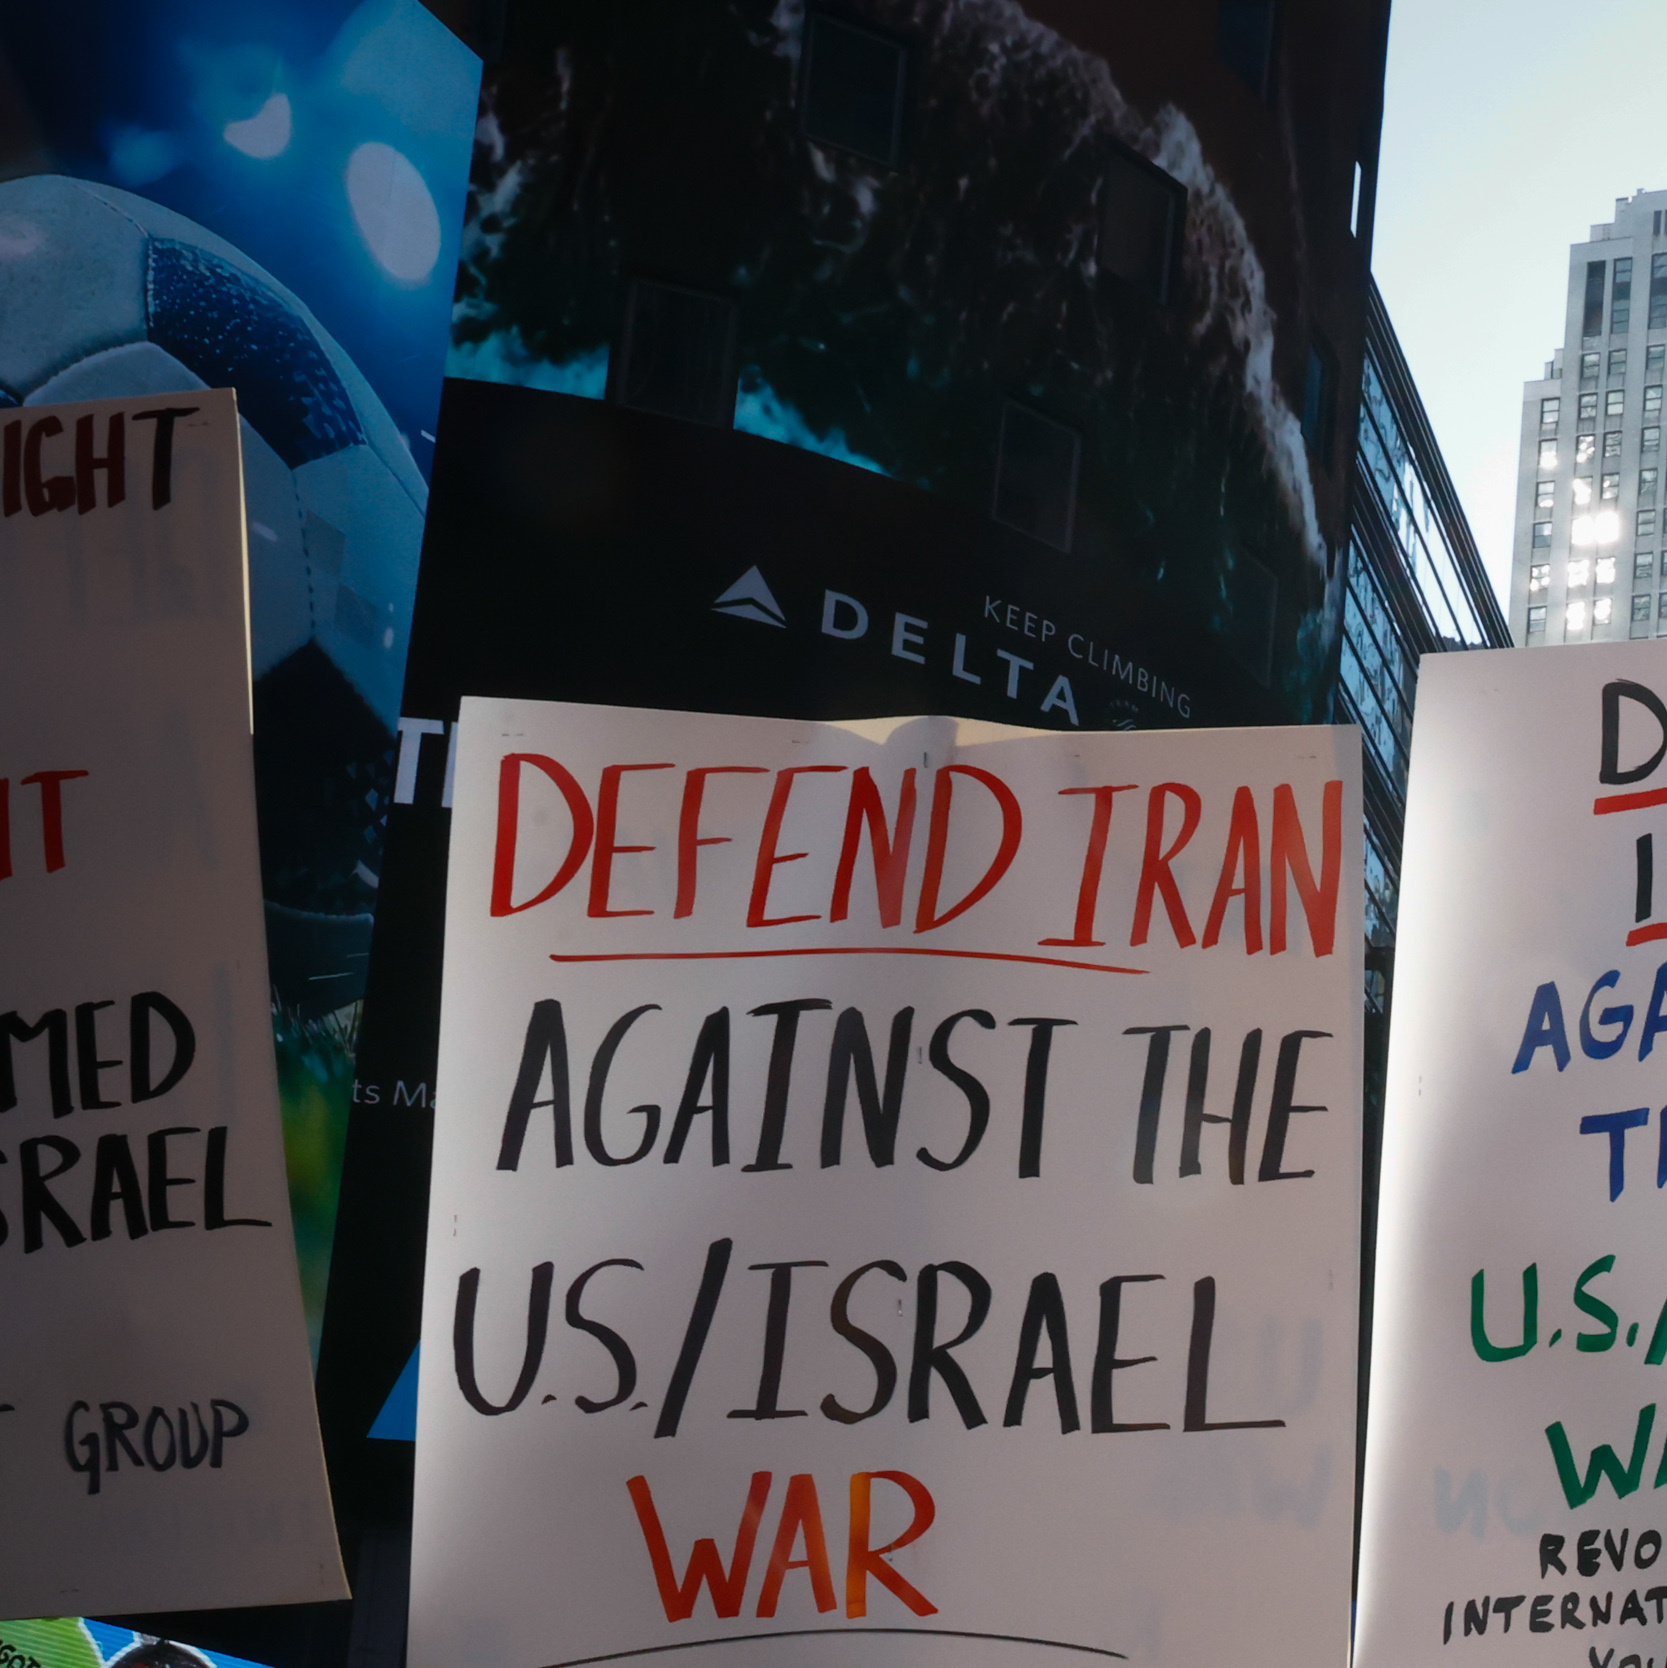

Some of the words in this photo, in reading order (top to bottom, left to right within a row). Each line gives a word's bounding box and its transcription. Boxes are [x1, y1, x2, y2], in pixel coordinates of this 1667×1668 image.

[2, 407, 199, 517] IGHT
[821, 589, 1080, 727] DELTA
[984, 594, 1057, 644] KEEP
[1067, 633, 1191, 720] CLIMBING
[491, 753, 1022, 934] DEFEND
[1038, 780, 1343, 957] IRAN
[496, 998, 1078, 1172] AGAINST
[1122, 1024, 1334, 1186] THE
[453, 1237, 1286, 1439] U.S./ISRAEL
[65, 1399, 250, 1494] GROUP
[626, 1470, 939, 1622] WAR
